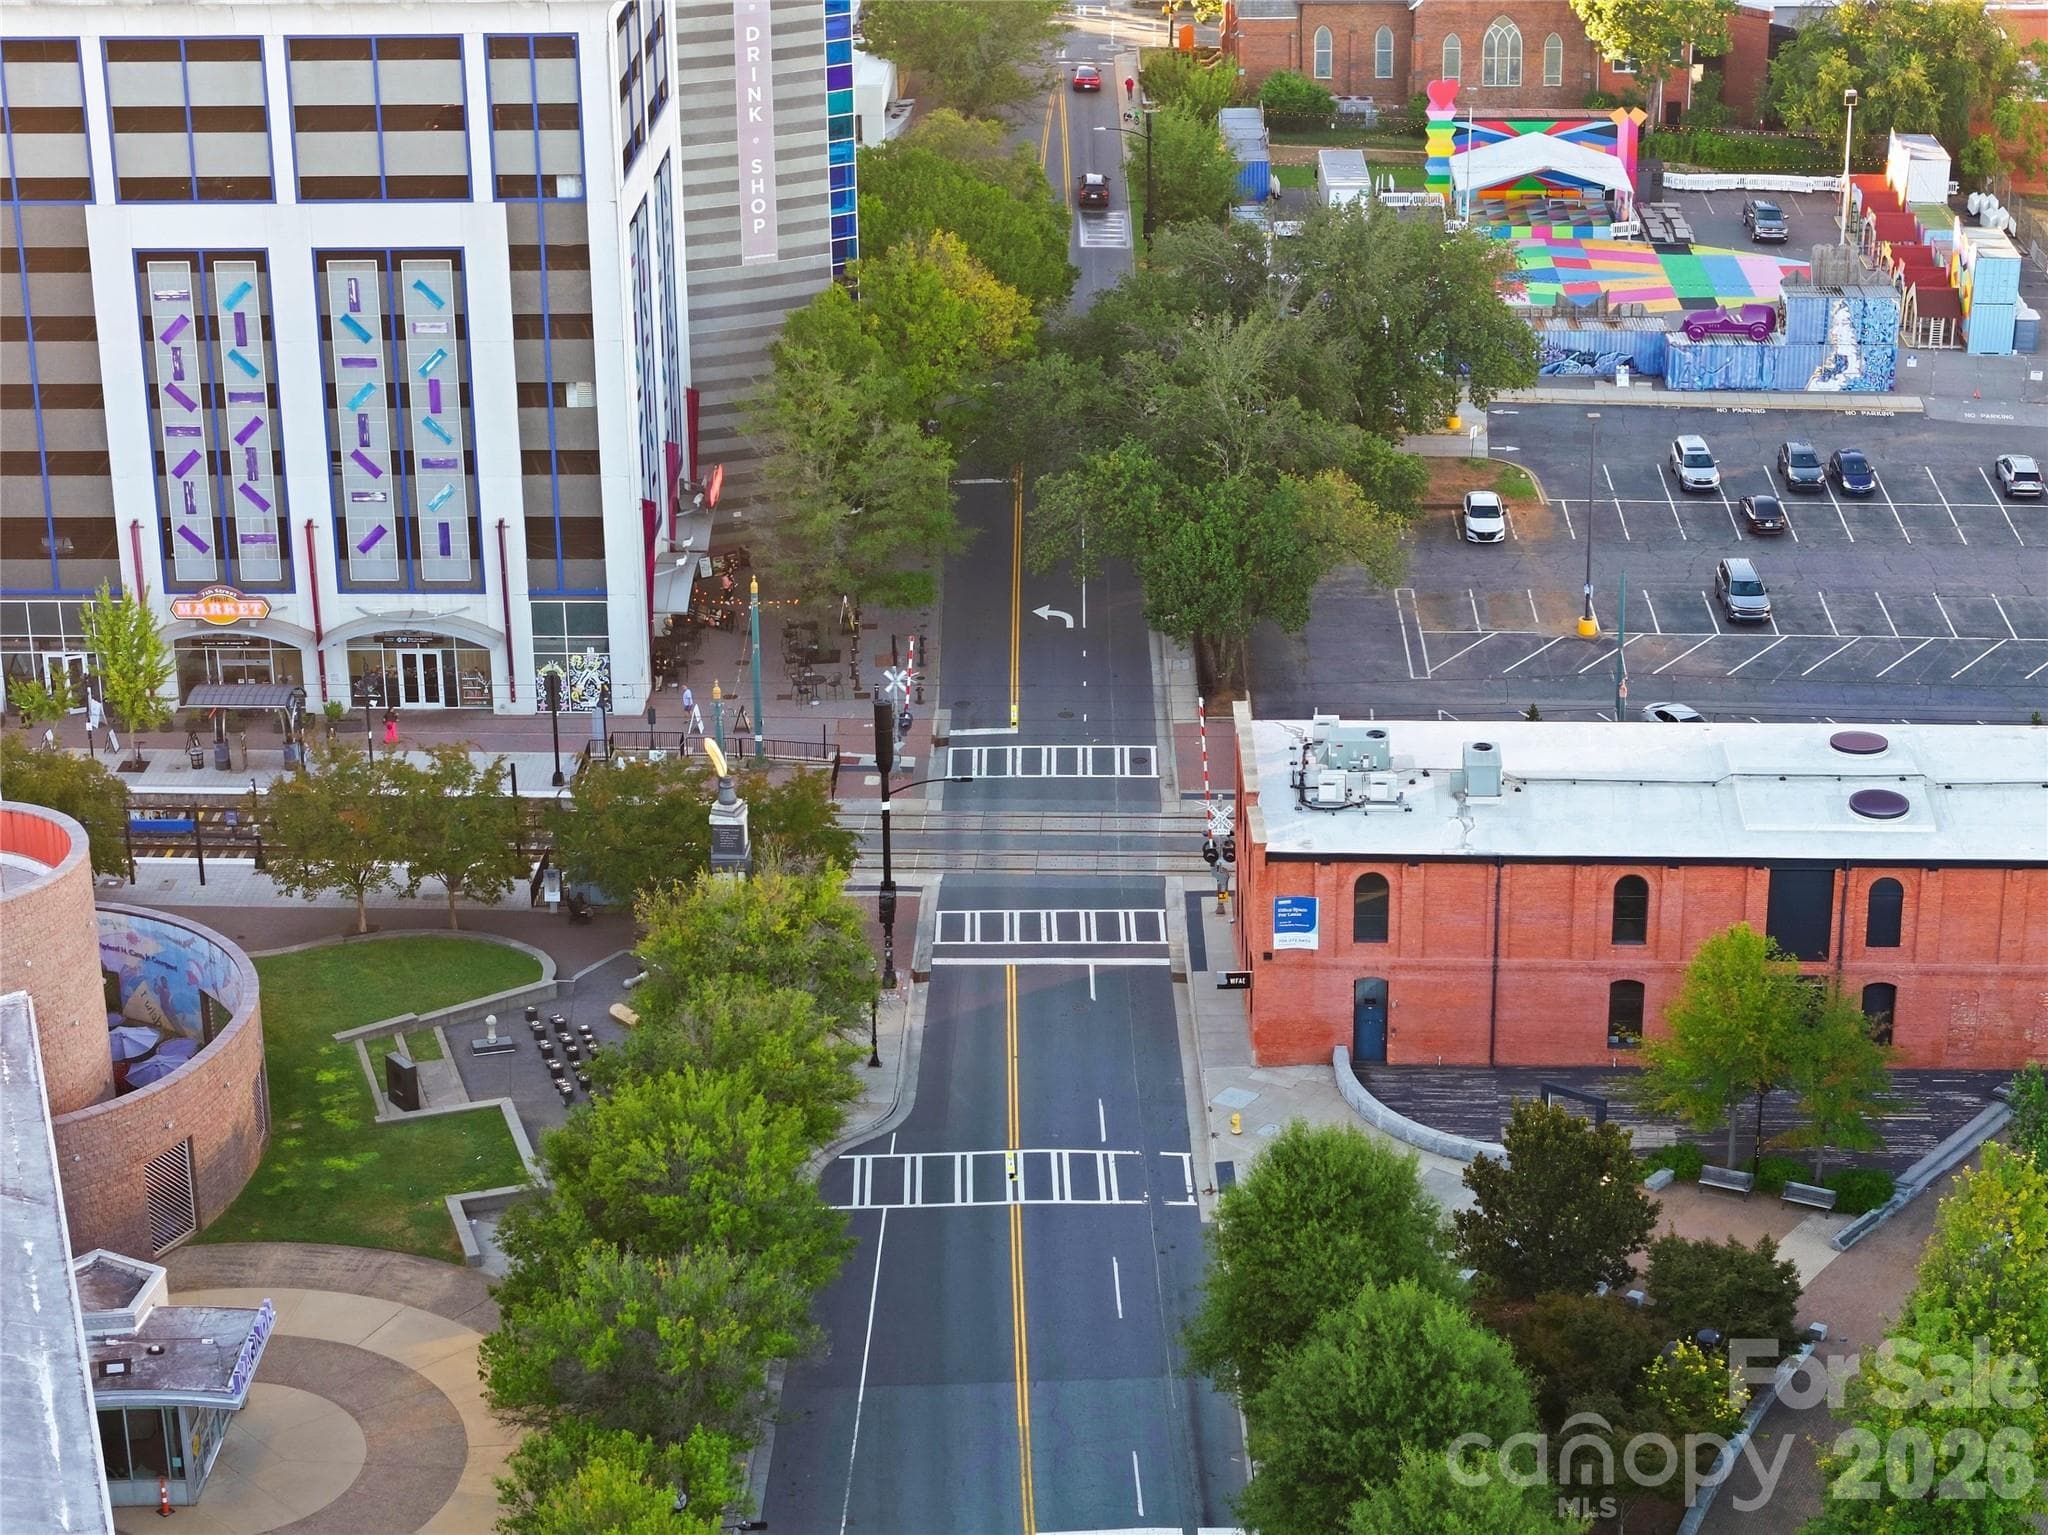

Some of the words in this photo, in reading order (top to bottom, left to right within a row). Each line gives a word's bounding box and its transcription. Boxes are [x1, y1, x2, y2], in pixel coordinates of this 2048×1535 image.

[746, 26, 763, 122] DRINK
[751, 159, 766, 234] SHOP
[177, 602, 261, 615] MARKET
[214, 588, 237, 597] Street
